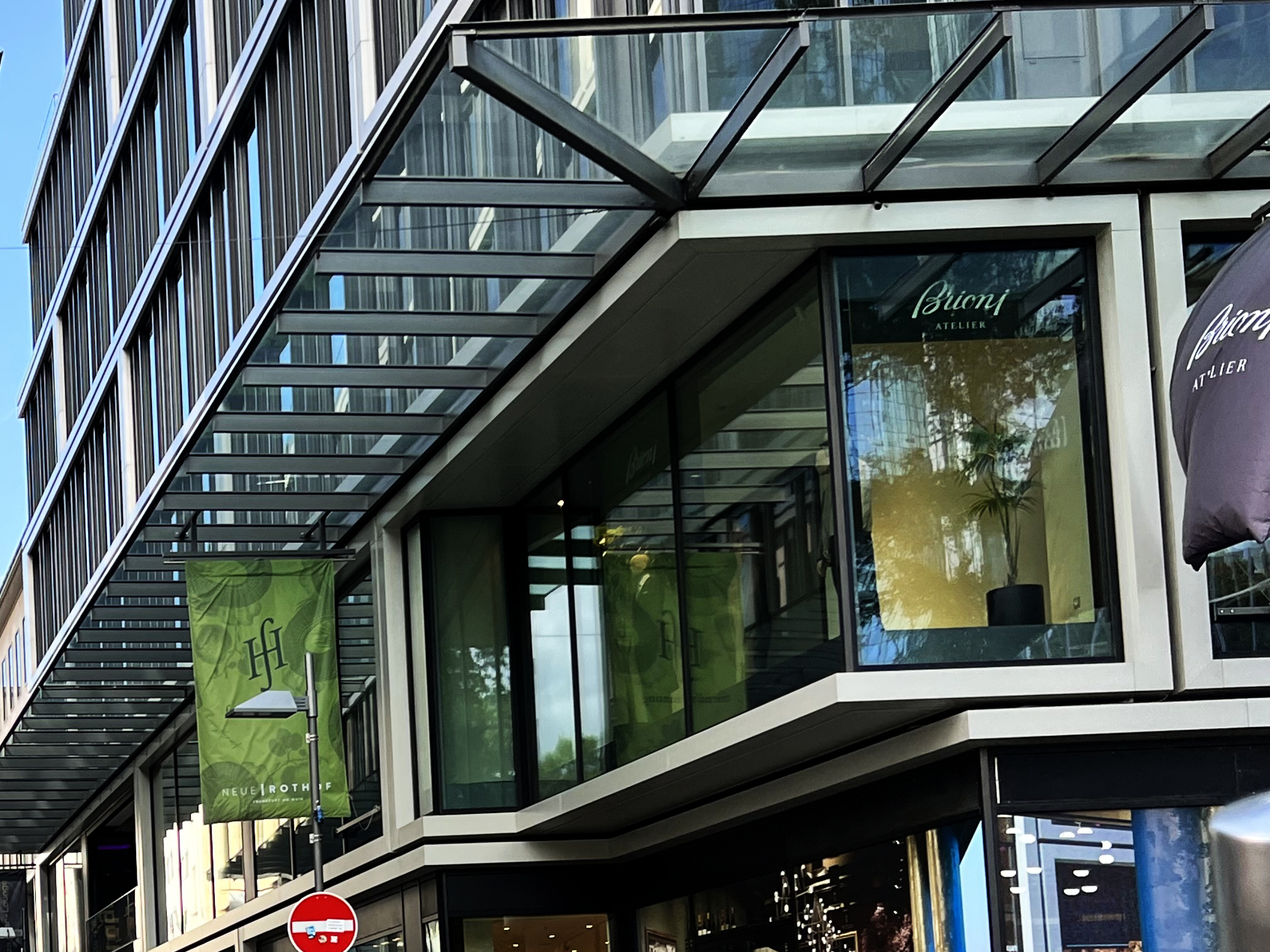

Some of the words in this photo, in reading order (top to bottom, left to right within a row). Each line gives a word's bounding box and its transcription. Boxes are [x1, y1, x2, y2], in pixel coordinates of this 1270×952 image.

[911, 279, 1010, 319] Brioni
[935, 321, 986, 330] ATELIER
[1191, 358, 1248, 393] ATLIER
[221, 785, 257, 797] NEUE
[268, 782, 332, 794] ROTHF
